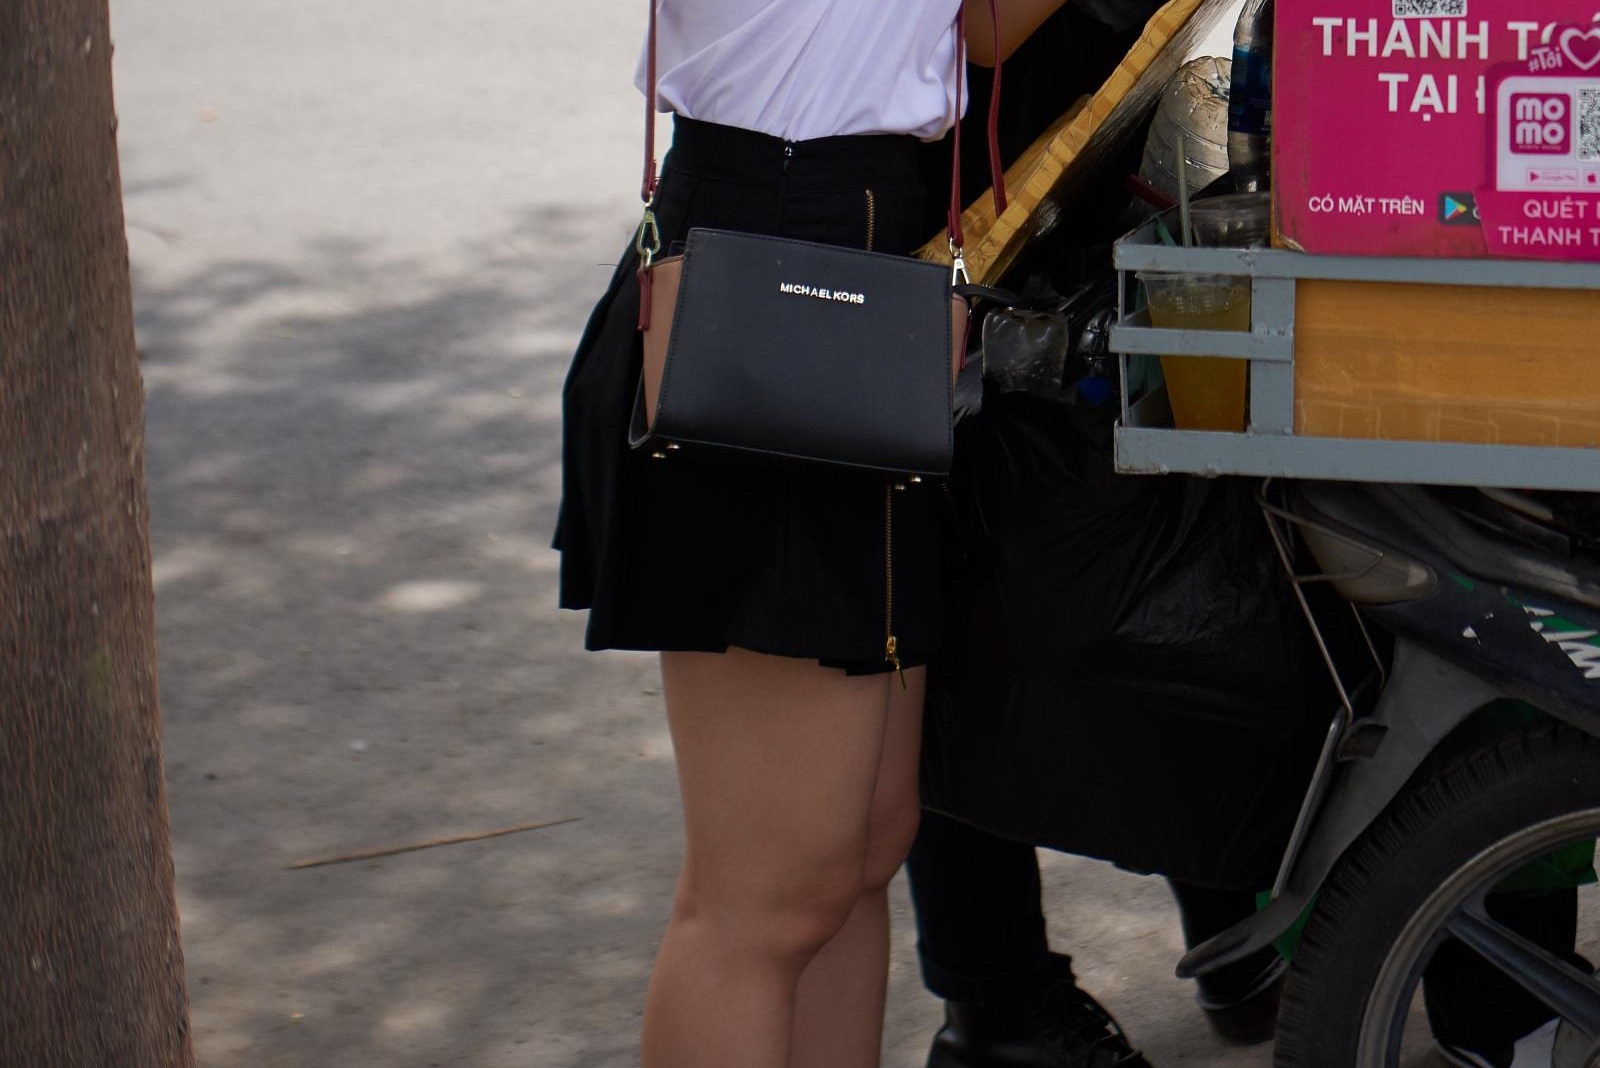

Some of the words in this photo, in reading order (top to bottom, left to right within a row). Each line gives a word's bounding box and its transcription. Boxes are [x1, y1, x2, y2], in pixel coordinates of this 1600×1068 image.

[1312, 17, 1489, 60] THANH
[1378, 73, 1457, 122] TẠI
[1309, 193, 1334, 213] CÓ
[1338, 195, 1375, 216] MẶT
[1379, 196, 1425, 215] TRÊN
[1523, 196, 1589, 219] QUÉT
[1498, 226, 1582, 246] THANH
[780, 282, 832, 299] MICHAEL
[833, 291, 865, 304] KORS
